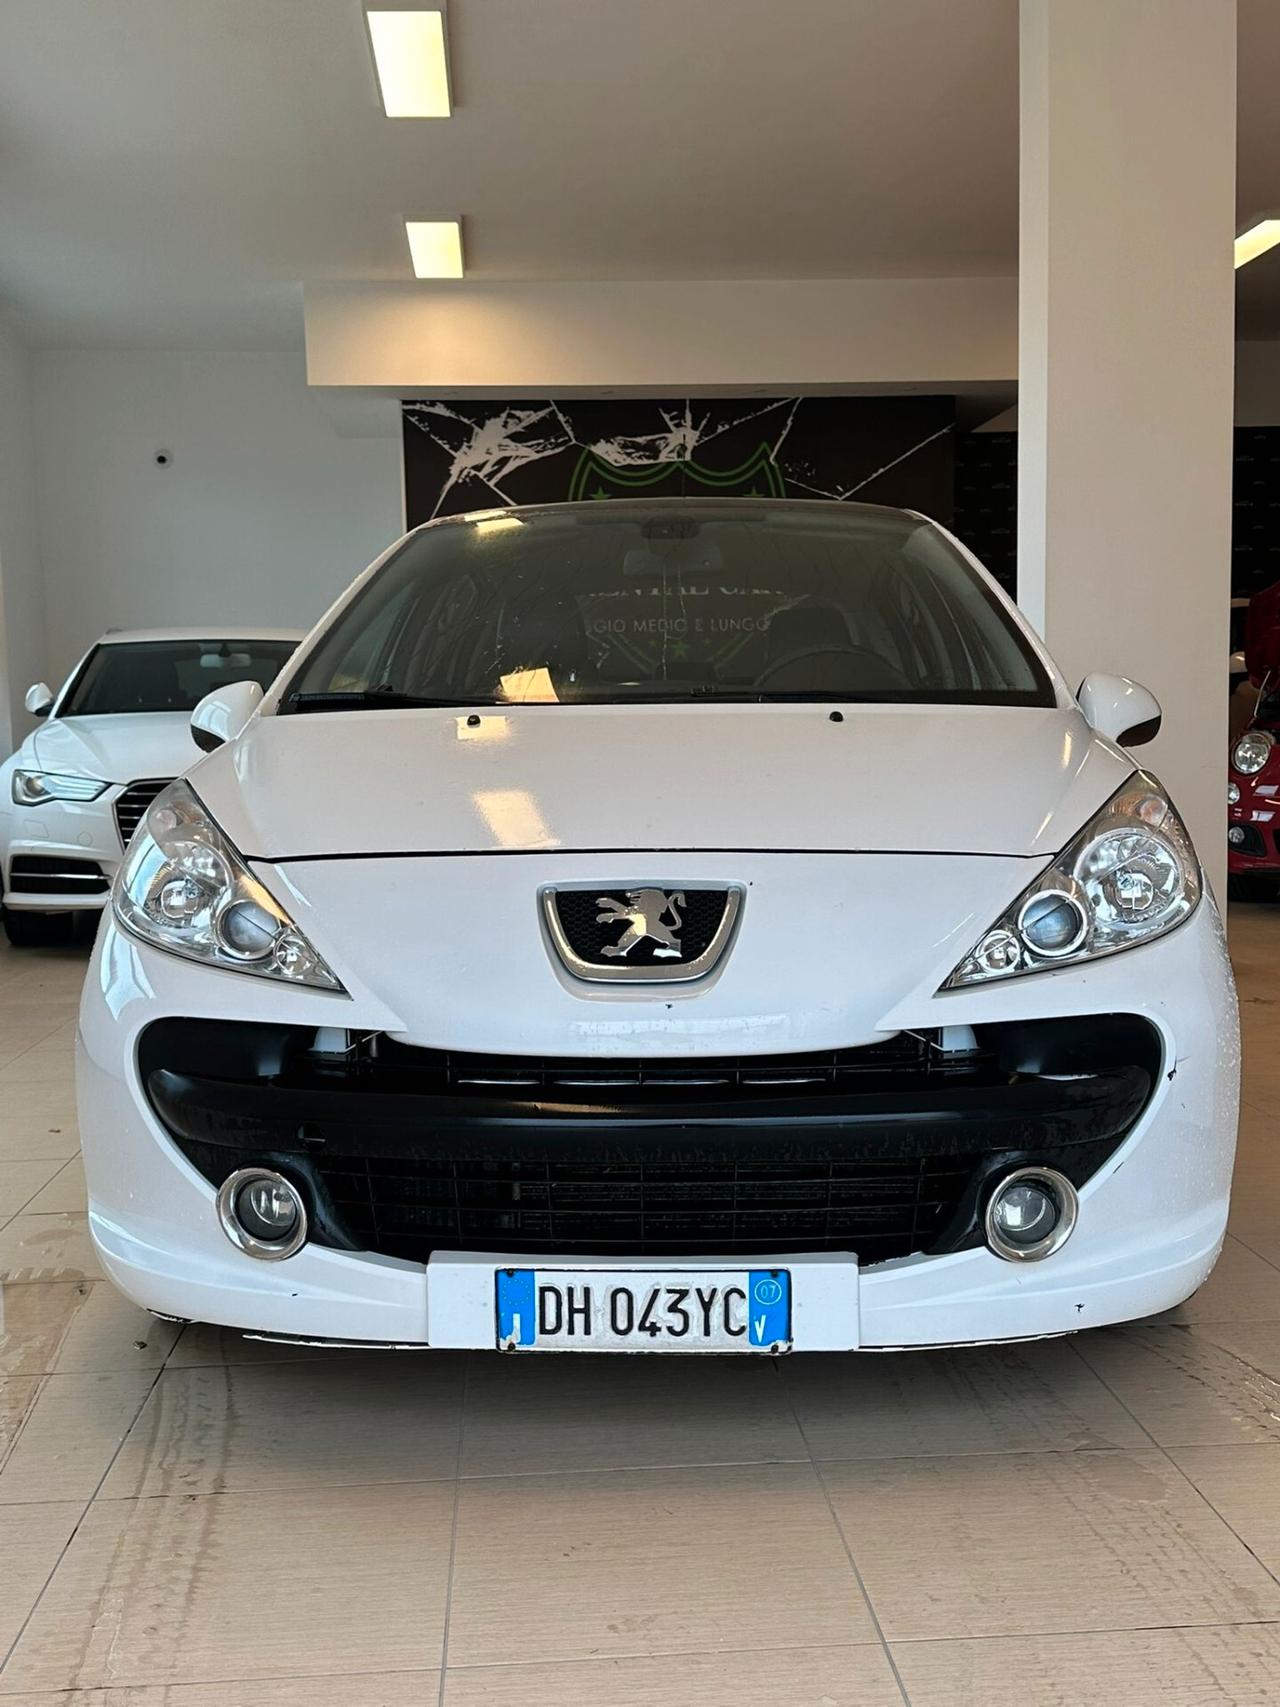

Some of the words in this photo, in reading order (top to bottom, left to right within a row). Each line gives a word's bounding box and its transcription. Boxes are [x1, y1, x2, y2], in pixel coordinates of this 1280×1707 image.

[761, 1285, 776, 1298] 07
[539, 1286, 592, 1335] DH
[610, 1287, 746, 1337] 043YC
